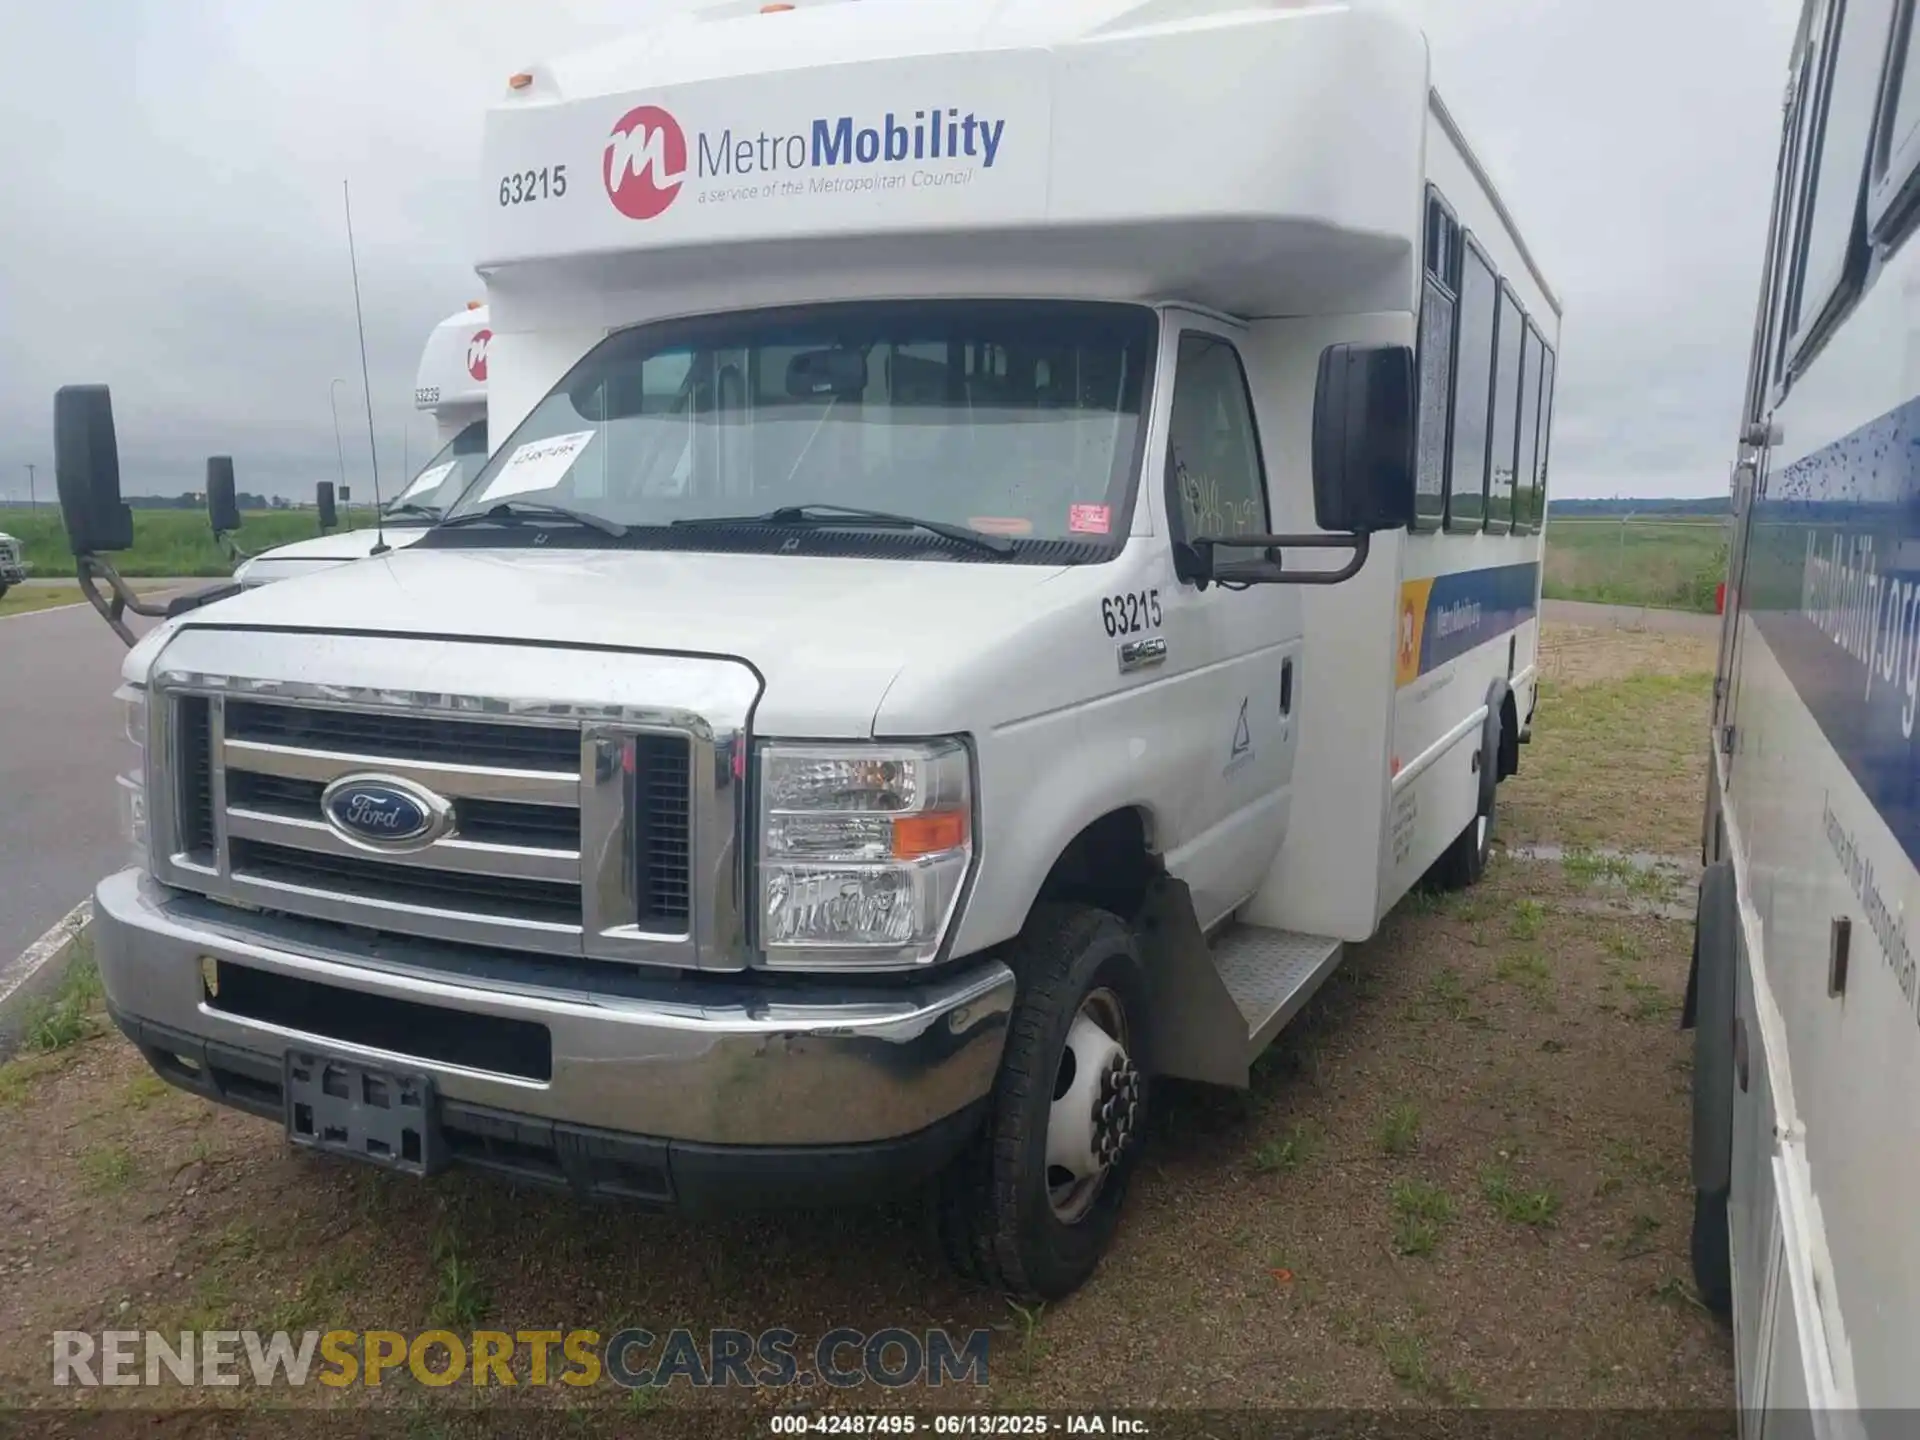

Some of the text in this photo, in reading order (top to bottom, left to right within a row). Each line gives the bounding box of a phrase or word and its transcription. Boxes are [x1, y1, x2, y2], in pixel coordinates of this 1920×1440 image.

[499, 164, 567, 207] 63215
[710, 186, 758, 202] service
[762, 182, 777, 199] of
[780, 181, 803, 197] the
[808, 172, 907, 195] Metropolitan
[911, 168, 973, 188] Council
[1101, 589, 1162, 638] 63215
[346, 793, 400, 828] Ford
